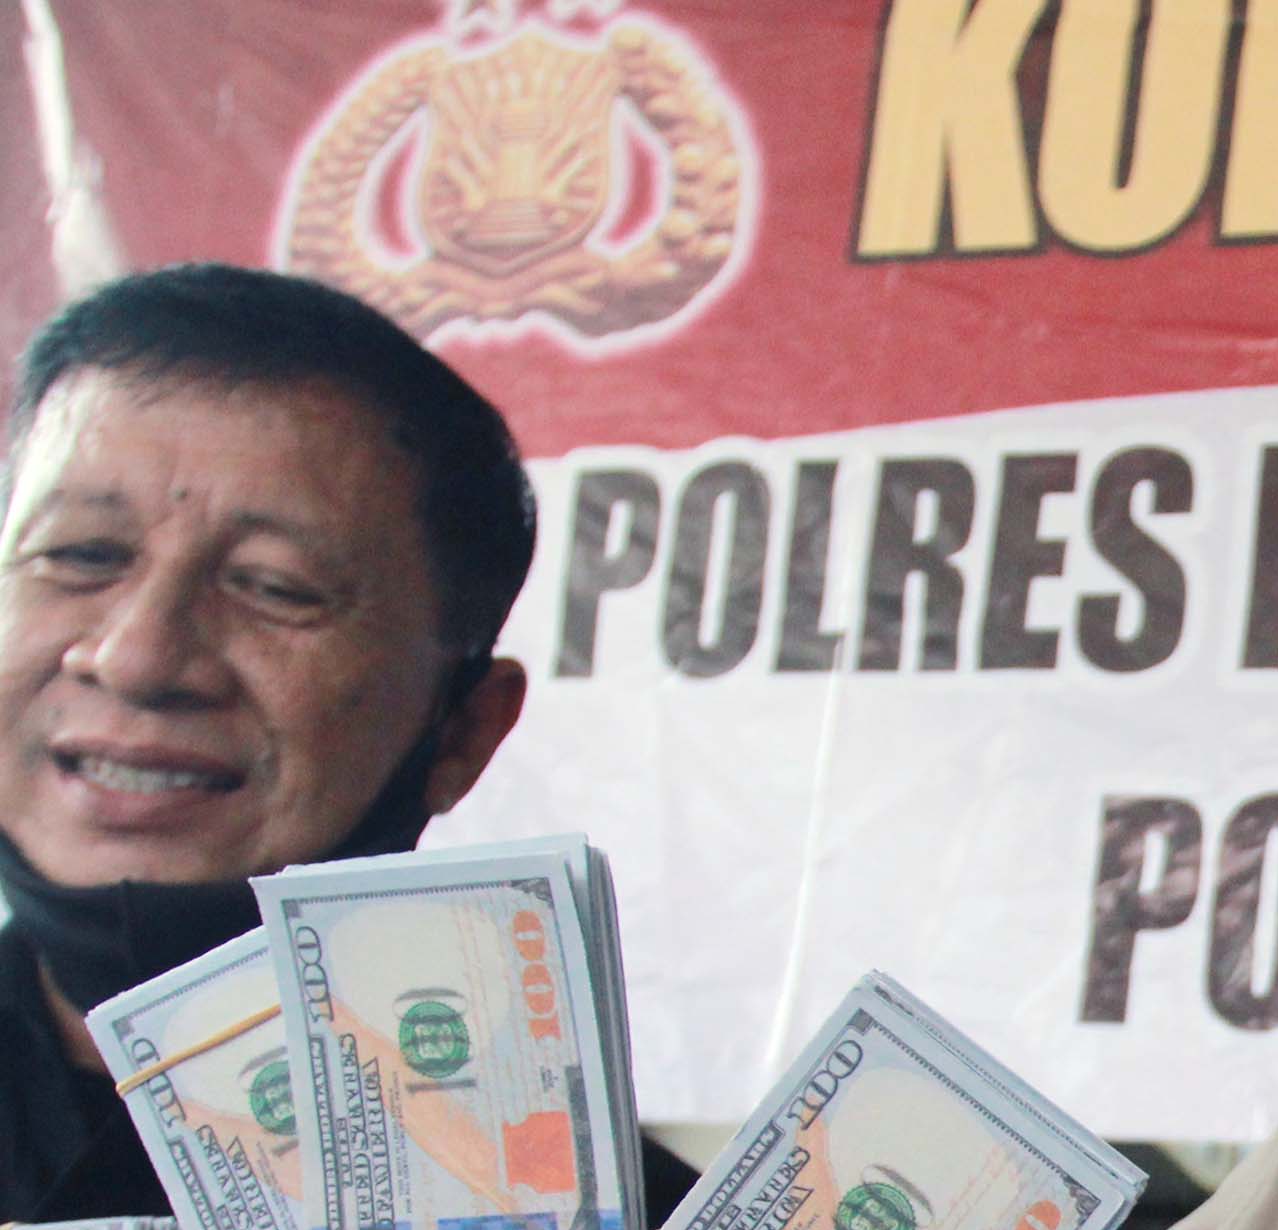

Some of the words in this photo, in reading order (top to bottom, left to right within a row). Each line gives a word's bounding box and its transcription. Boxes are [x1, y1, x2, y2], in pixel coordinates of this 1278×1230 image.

[552, 444, 1194, 678] POLRES
[295, 924, 333, 1024] 100
[511, 909, 563, 1042] 100
[782, 1031, 869, 1133] 100
